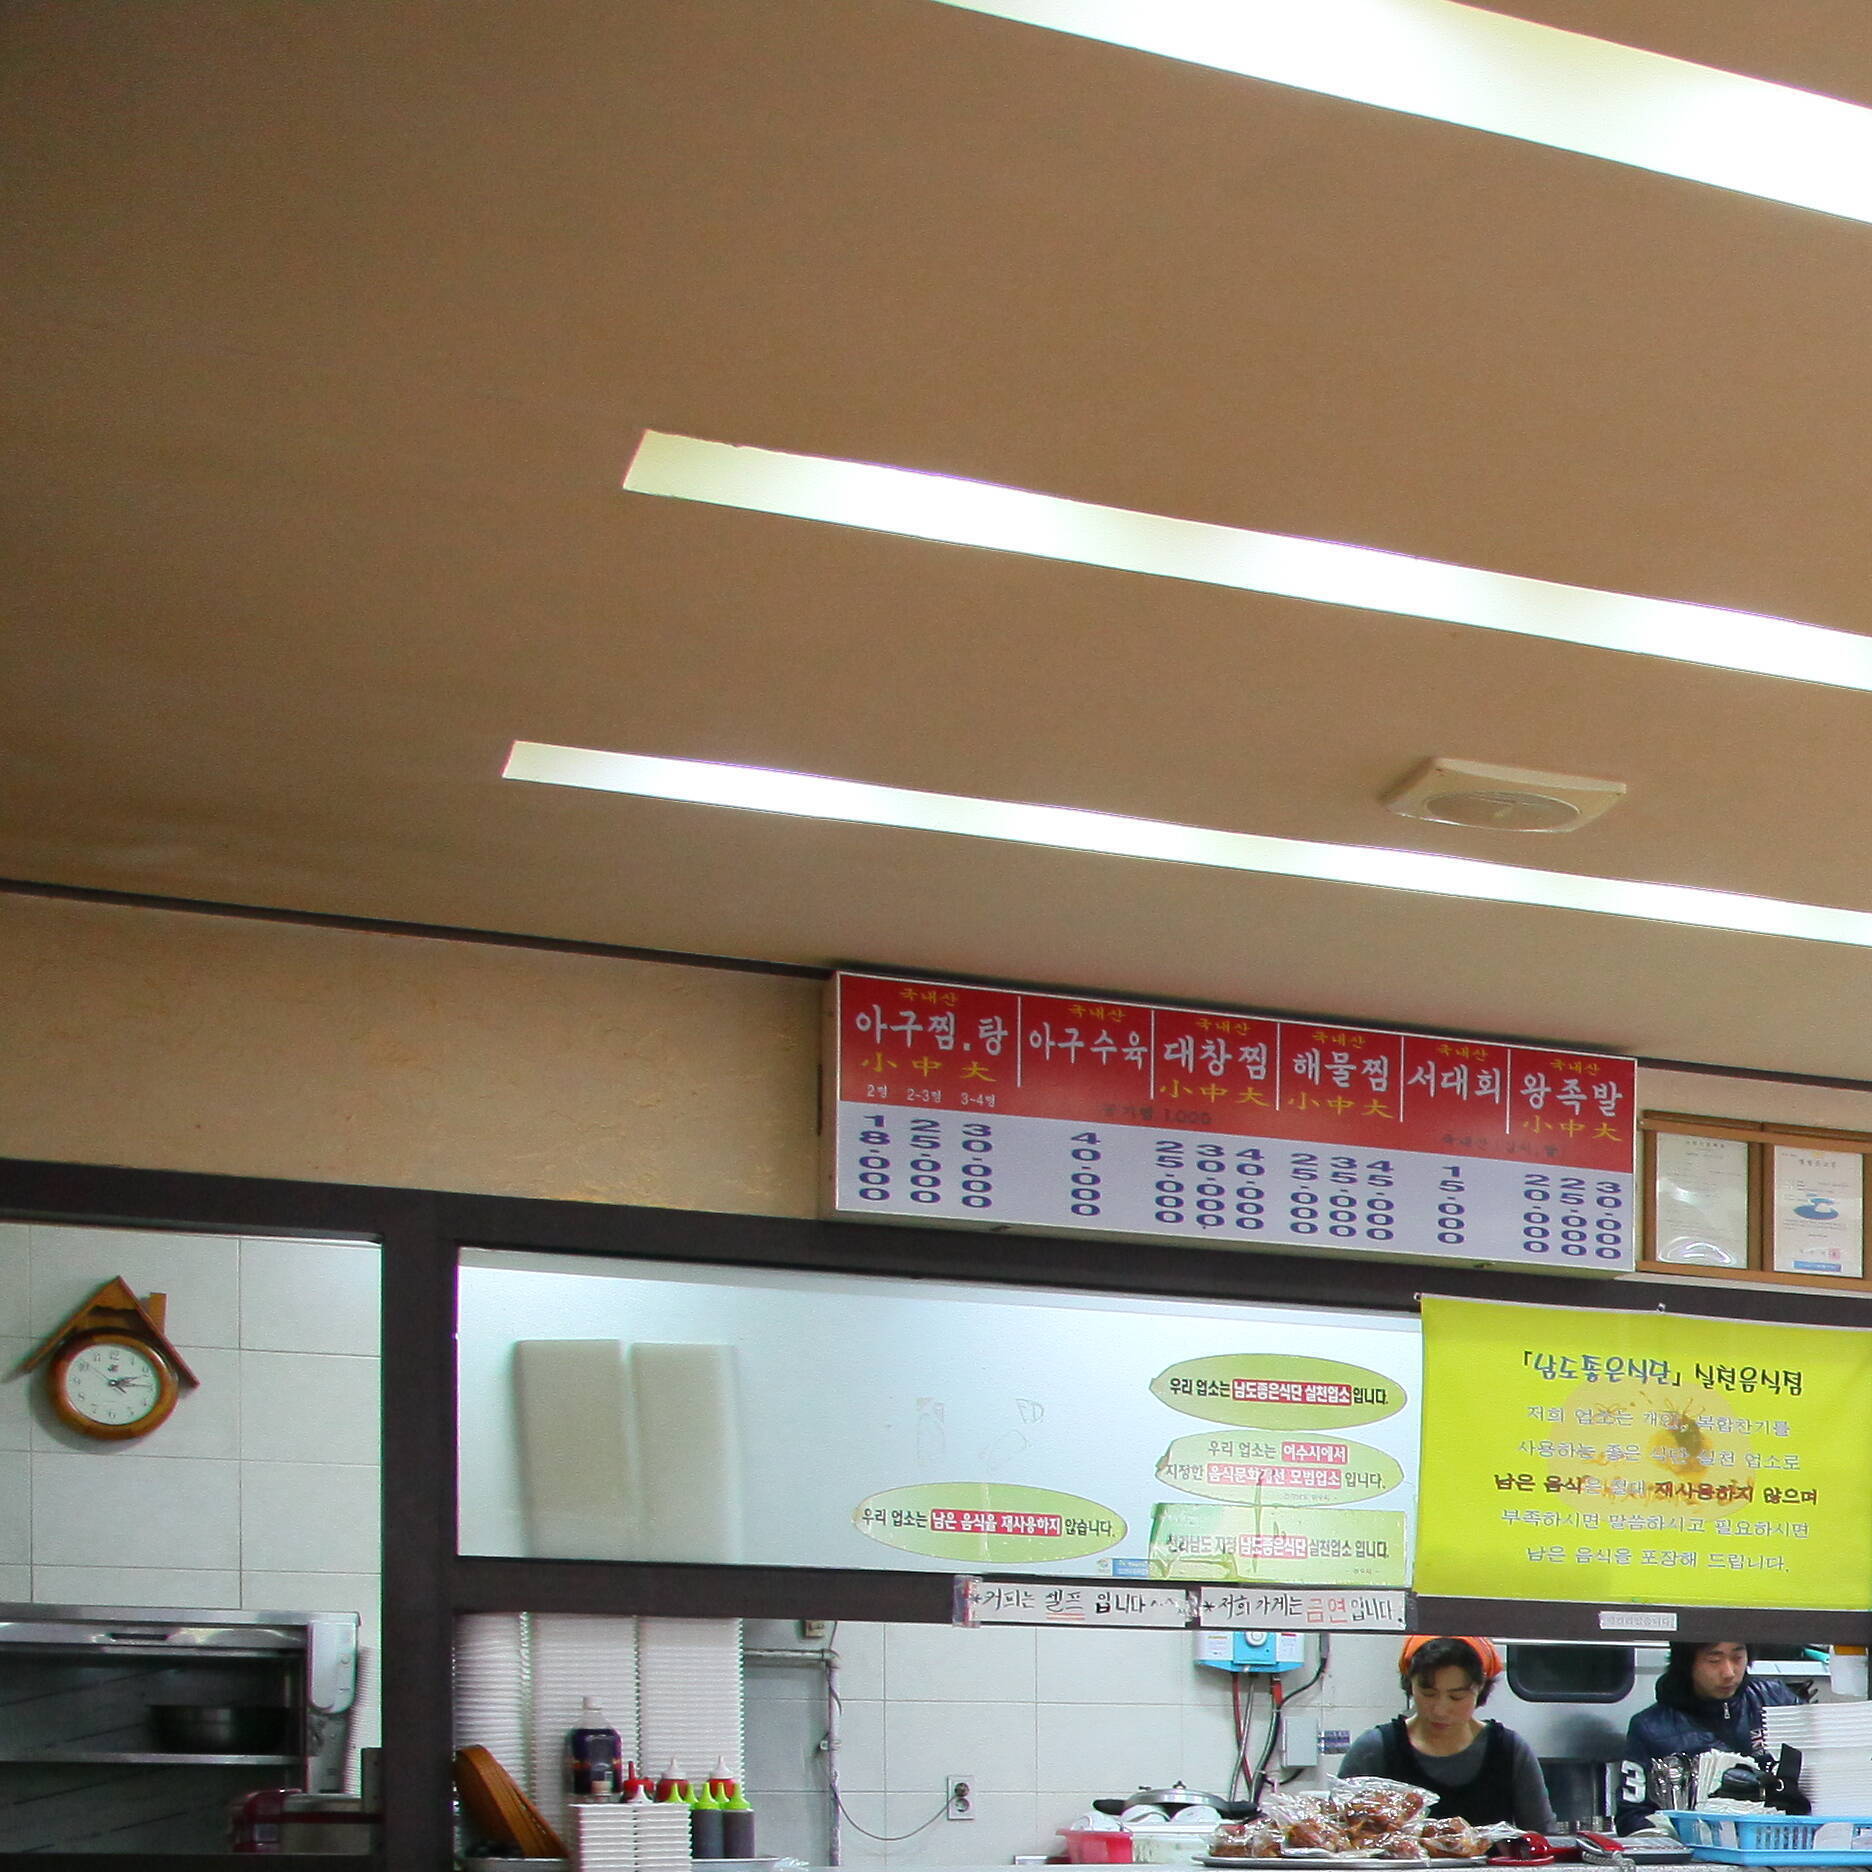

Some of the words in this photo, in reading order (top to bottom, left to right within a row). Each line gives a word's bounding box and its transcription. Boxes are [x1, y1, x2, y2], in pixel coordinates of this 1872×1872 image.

[900, 988, 958, 1007] 국내산
[1069, 1005, 1126, 1022] 국내산
[1197, 1017, 1252, 1037] 국내산
[1029, 1023, 1148, 1070] 아구수육
[1313, 1032, 1365, 1049] 국내산
[1437, 1043, 1488, 1062] 국내산
[862, 1052, 897, 1073] 小
[912, 1057, 941, 1077] 中
[961, 1060, 996, 1083] 大
[1164, 1034, 1267, 1081] 대창찜
[1293, 1049, 1388, 1092] 해물찜
[1550, 1059, 1600, 1076] 국내산
[1159, 1079, 1193, 1097] 小
[1201, 1083, 1228, 1103] 中
[1239, 1087, 1269, 1108] 大
[1408, 1061, 1500, 1104] 서대회
[1520, 1072, 1622, 1117] 왕족발
[1288, 1092, 1320, 1108] 小
[1327, 1096, 1353, 1115] 中
[1363, 1098, 1393, 1119] 大
[1524, 1116, 1552, 1135] 小
[1559, 1120, 1585, 1137] 中
[1594, 1122, 1622, 1143] 大
[1170, 1377, 1192, 1395] 우리
[1196, 1379, 1230, 1398] 업소는
[1234, 1382, 1303, 1401] 남도좋은식단
[1305, 1386, 1350, 1403] 실천업소
[1354, 1388, 1388, 1405] 입니다.
[1695, 1362, 1803, 1396] 실천음식점
[1527, 1405, 1565, 1423] 저희
[1575, 1408, 1634, 1426] 업소는
[1208, 1441, 1233, 1457] 우리
[1239, 1442, 1276, 1459] 업소는
[1283, 1444, 1346, 1462] 여수시에서
[1519, 1440, 1597, 1459] 사용하는
[1745, 1453, 1800, 1470] 업소로
[1166, 1464, 1204, 1480] 지정한
[1290, 1469, 1341, 1486] 모범업소
[1345, 1472, 1386, 1489] 입니다.
[1494, 1473, 1536, 1492] 남은
[1655, 1481, 1754, 1503] 재사용하지
[1763, 1487, 1818, 1505] 않으며
[862, 1509, 886, 1526] 우리
[892, 1510, 928, 1527] 업소는
[932, 1512, 957, 1530] 남은
[961, 1514, 997, 1532] 음식을
[1001, 1516, 1062, 1535] 재사용하지
[1065, 1519, 1116, 1538] 않습니다.
[1501, 1509, 1600, 1529] 부족하시면
[1609, 1513, 1706, 1533] 말씀하시고
[1715, 1520, 1809, 1539] 필요하시면
[1355, 1541, 1390, 1558] 입니다.
[1528, 1546, 1566, 1563] 남은
[1576, 1547, 1632, 1565] 음식을
[1641, 1550, 1697, 1568] 포장해
[1708, 1553, 1789, 1572] 드립니다.
[1045, 1589, 1083, 1613] 셀프
[1096, 1592, 1146, 1613] 입니다
[1221, 1594, 1250, 1619] 저희
[1256, 1593, 1303, 1618] 가게는
[1306, 1598, 1348, 1624] 금연
